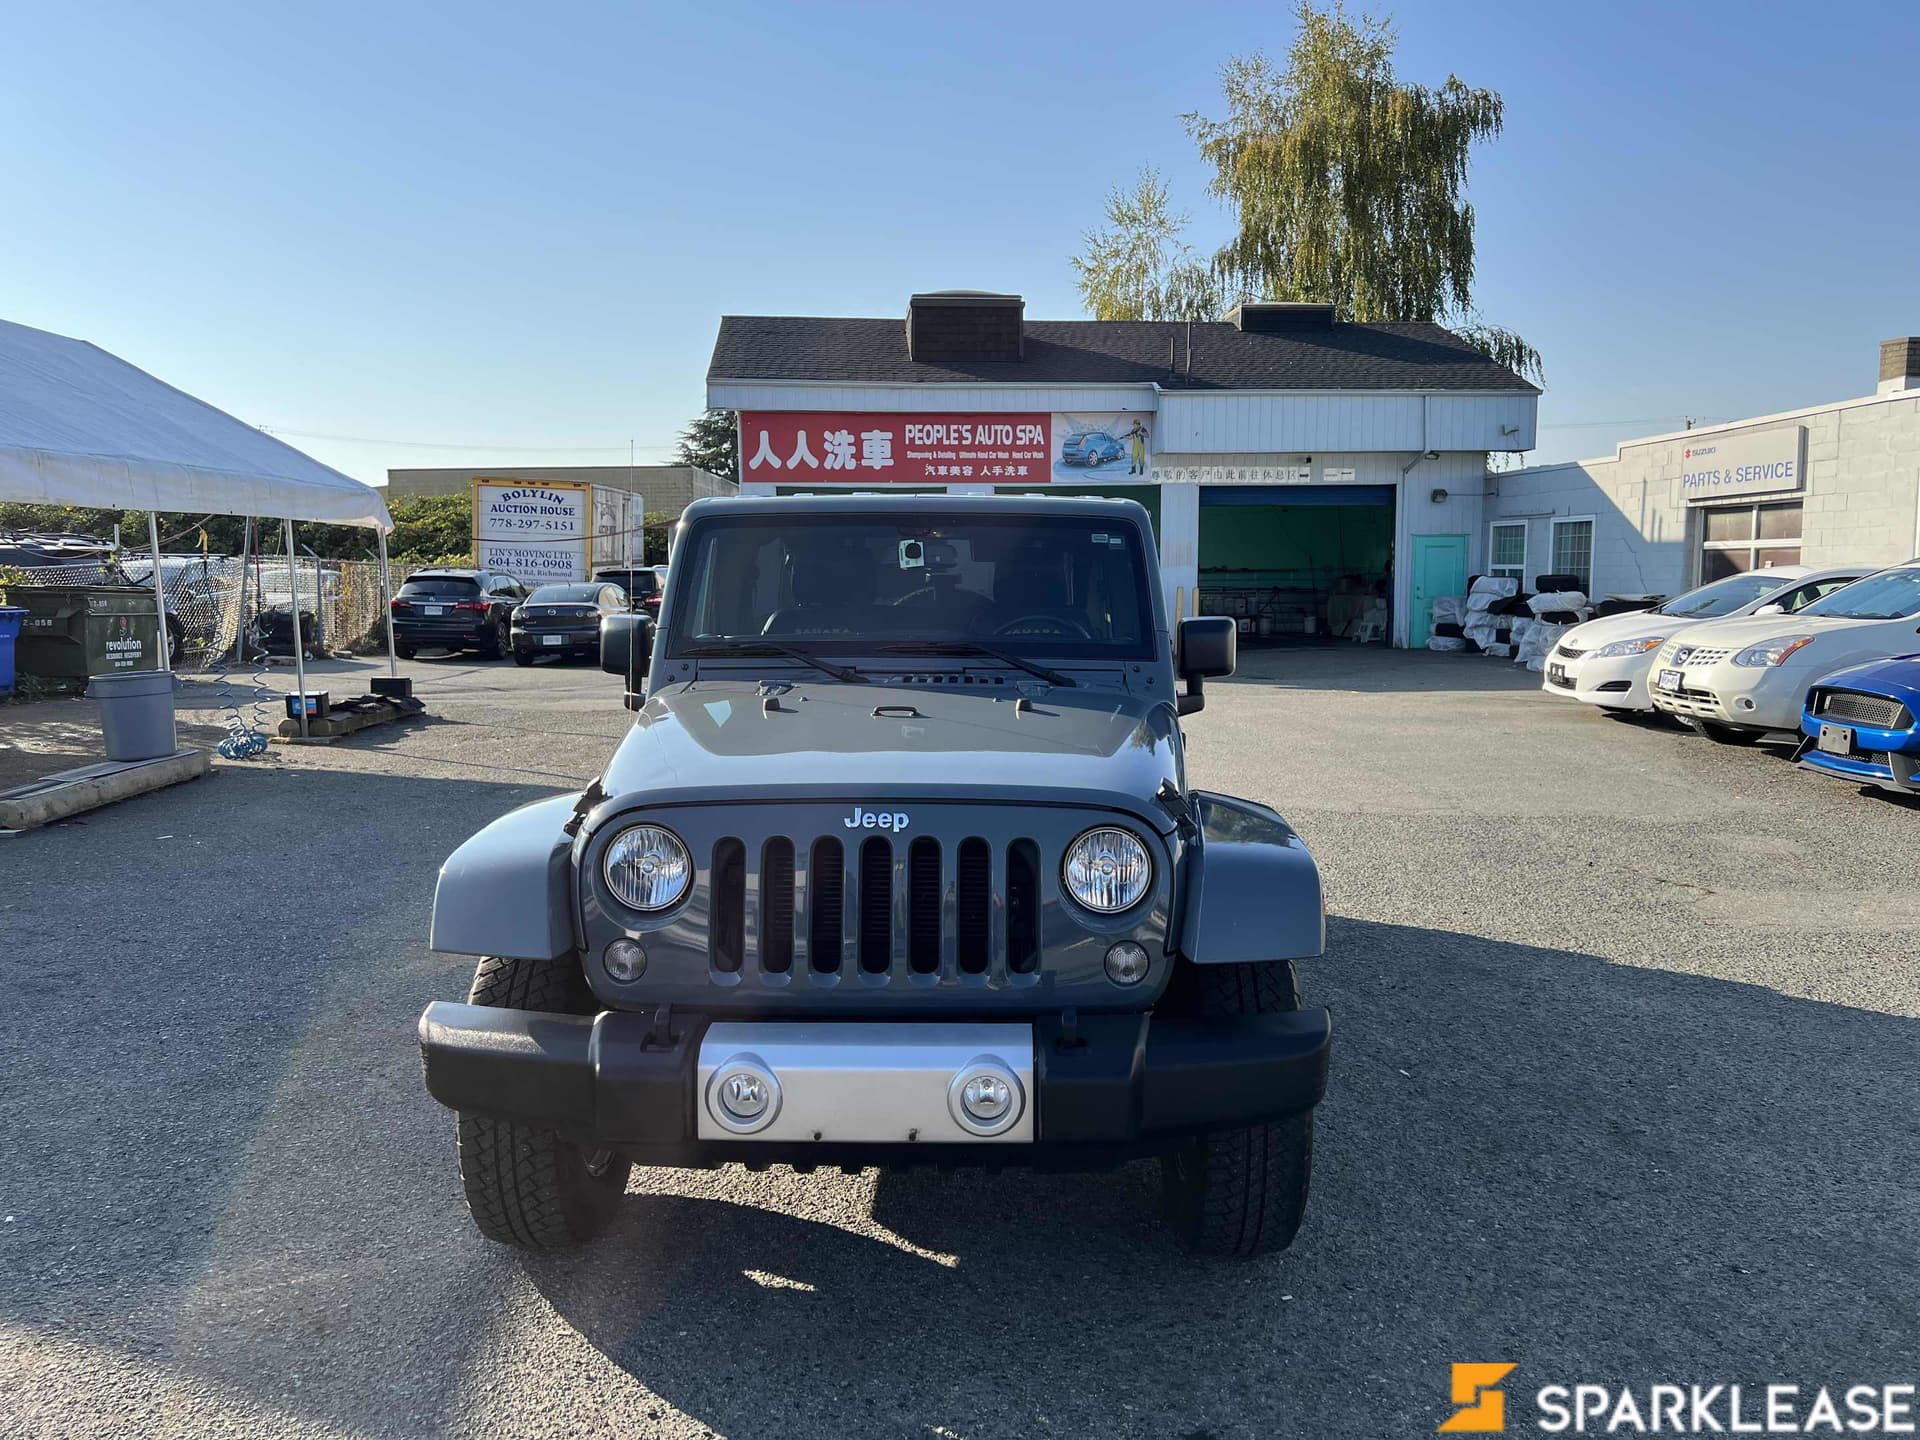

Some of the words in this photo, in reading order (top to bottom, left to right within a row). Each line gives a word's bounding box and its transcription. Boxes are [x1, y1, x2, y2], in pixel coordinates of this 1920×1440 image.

[904, 424, 972, 446] PEOPLE'S
[974, 424, 1013, 446] AUTO
[1015, 424, 1045, 446] SPA
[748, 429, 895, 471] 人人洗車
[924, 463, 974, 476] 汽車美容
[979, 464, 1029, 476] 人手洗車
[1682, 470, 1721, 488] PARTS
[1723, 469, 1732, 484] &
[1735, 461, 1793, 483] SERVICE
[501, 489, 565, 505] BOLYLIN
[490, 504, 537, 515] AUCTION
[540, 506, 575, 516] HOUSE
[489, 518, 574, 531] 778-297-5151
[514, 549, 552, 559] MOVING
[488, 557, 573, 569] 604-816-0908
[105, 637, 142, 651] revolution
[844, 807, 909, 833] Jeep
